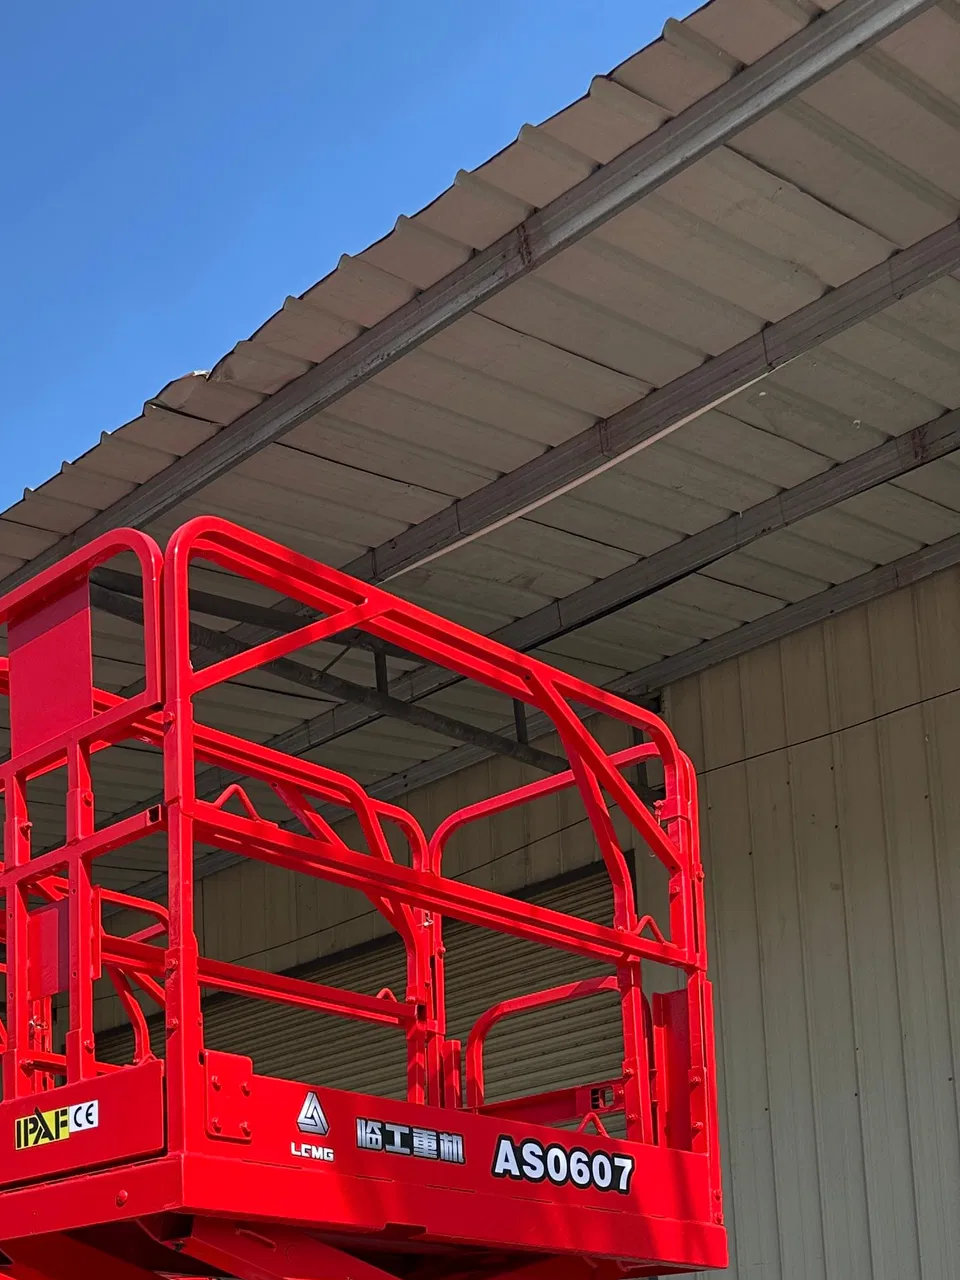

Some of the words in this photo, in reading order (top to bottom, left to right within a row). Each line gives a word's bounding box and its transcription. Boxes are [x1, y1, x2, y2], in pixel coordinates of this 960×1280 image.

[16, 1107, 68, 1149] IPAF
[356, 1117, 465, 1164] 临工重机
[290, 1141, 335, 1162] LCMG
[494, 1139, 633, 1191] AS0607
